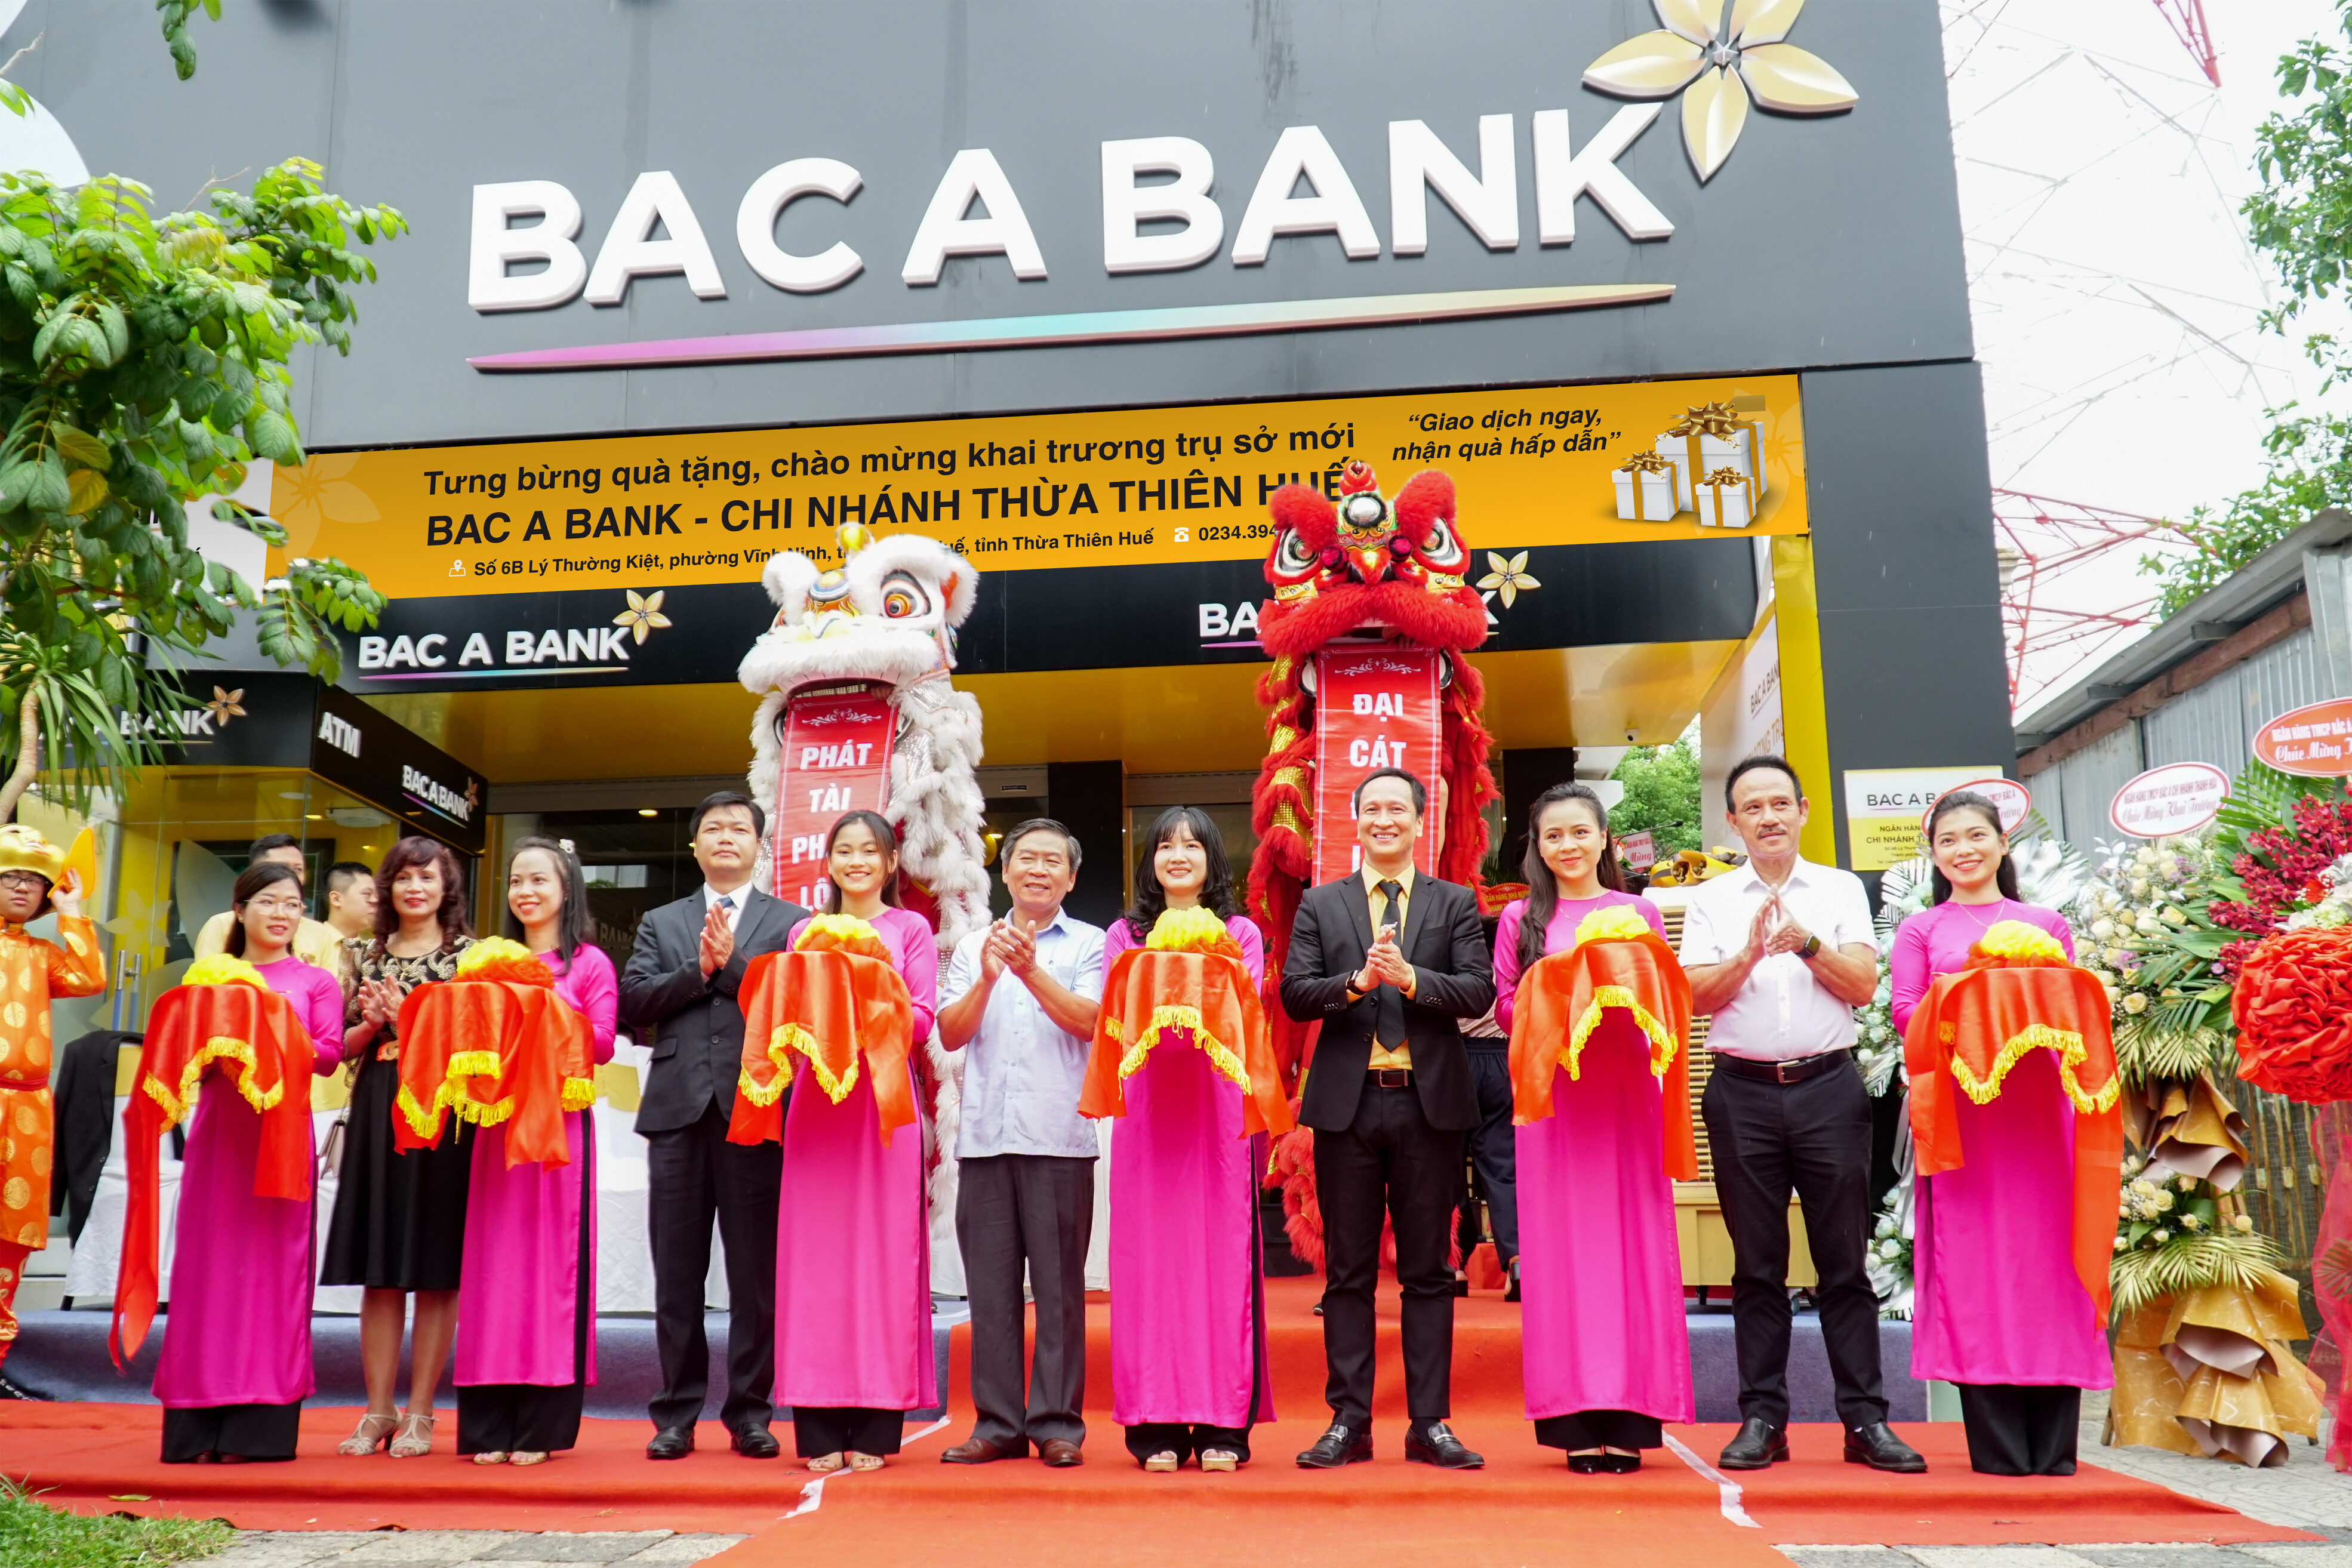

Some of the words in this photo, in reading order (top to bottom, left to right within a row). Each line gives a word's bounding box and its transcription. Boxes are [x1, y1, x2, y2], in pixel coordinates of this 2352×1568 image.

[468, 157, 864, 312] BAC
[900, 147, 1048, 285] A
[1101, 101, 1676, 272] BANK
[1482, 409, 1531, 430] dịch
[1540, 409, 1600, 428] ngay,
[424, 471, 506, 498] Tưng
[518, 464, 600, 494] bừng
[612, 458, 670, 491] quà
[681, 456, 759, 488] tặng,
[772, 450, 849, 477] chào
[862, 446, 956, 475] mừng
[969, 440, 1035, 467] khai
[1046, 439, 1164, 464] trương
[1176, 433, 1221, 461] trụ
[1234, 426, 1277, 454] sở
[1290, 423, 1353, 450] mới
[1393, 442, 1450, 463] nhận
[1459, 438, 1502, 461] quà
[1510, 433, 1555, 457] hấp
[427, 512, 510, 546] BAC
[523, 511, 551, 541] A
[566, 504, 682, 539] BANK
[722, 498, 792, 531] CHI
[809, 485, 959, 527] NHÁNH
[972, 477, 1098, 519] THỪA
[1110, 469, 1240, 512] THIÊN
[475, 562, 495, 575] Số
[502, 561, 522, 574] 6B
[529, 560, 548, 576] Lý
[553, 557, 620, 572] Thường
[627, 554, 663, 569] Kiệt,
[670, 552, 738, 569] phường
[975, 538, 1007, 552] tỉnh
[1012, 535, 1058, 550] Thừa
[1064, 533, 1112, 547] Thiên
[1119, 528, 1154, 545] Huế
[1199, 602, 1262, 637] BA
[359, 634, 447, 668] BAC
[458, 633, 494, 666] A
[506, 627, 630, 664] BANK
[1767, 660, 1778, 692] BAN
[1353, 692, 1403, 722] ĐẠI
[318, 711, 361, 758] ATM
[2271, 725, 2292, 742] NGÂN
[2291, 723, 2311, 740] HÀNG
[2310, 722, 2331, 737] TMCP
[800, 740, 872, 770] PHÁT
[1350, 735, 1406, 769] CÁT
[2275, 744, 2305, 762] Chúc
[2307, 741, 2342, 759] Mừng
[402, 765, 430, 798] BAC
[428, 781, 439, 804] A
[438, 785, 469, 821] BANK
[809, 783, 851, 812] TÀI
[1867, 794, 1903, 806] BAC
[1908, 793, 1921, 805] A
[792, 833, 828, 864] PH
[1630, 851, 1652, 863] Mừng
[1485, 893, 1495, 902] GÂN
[1495, 892, 1508, 901] HÀNG
